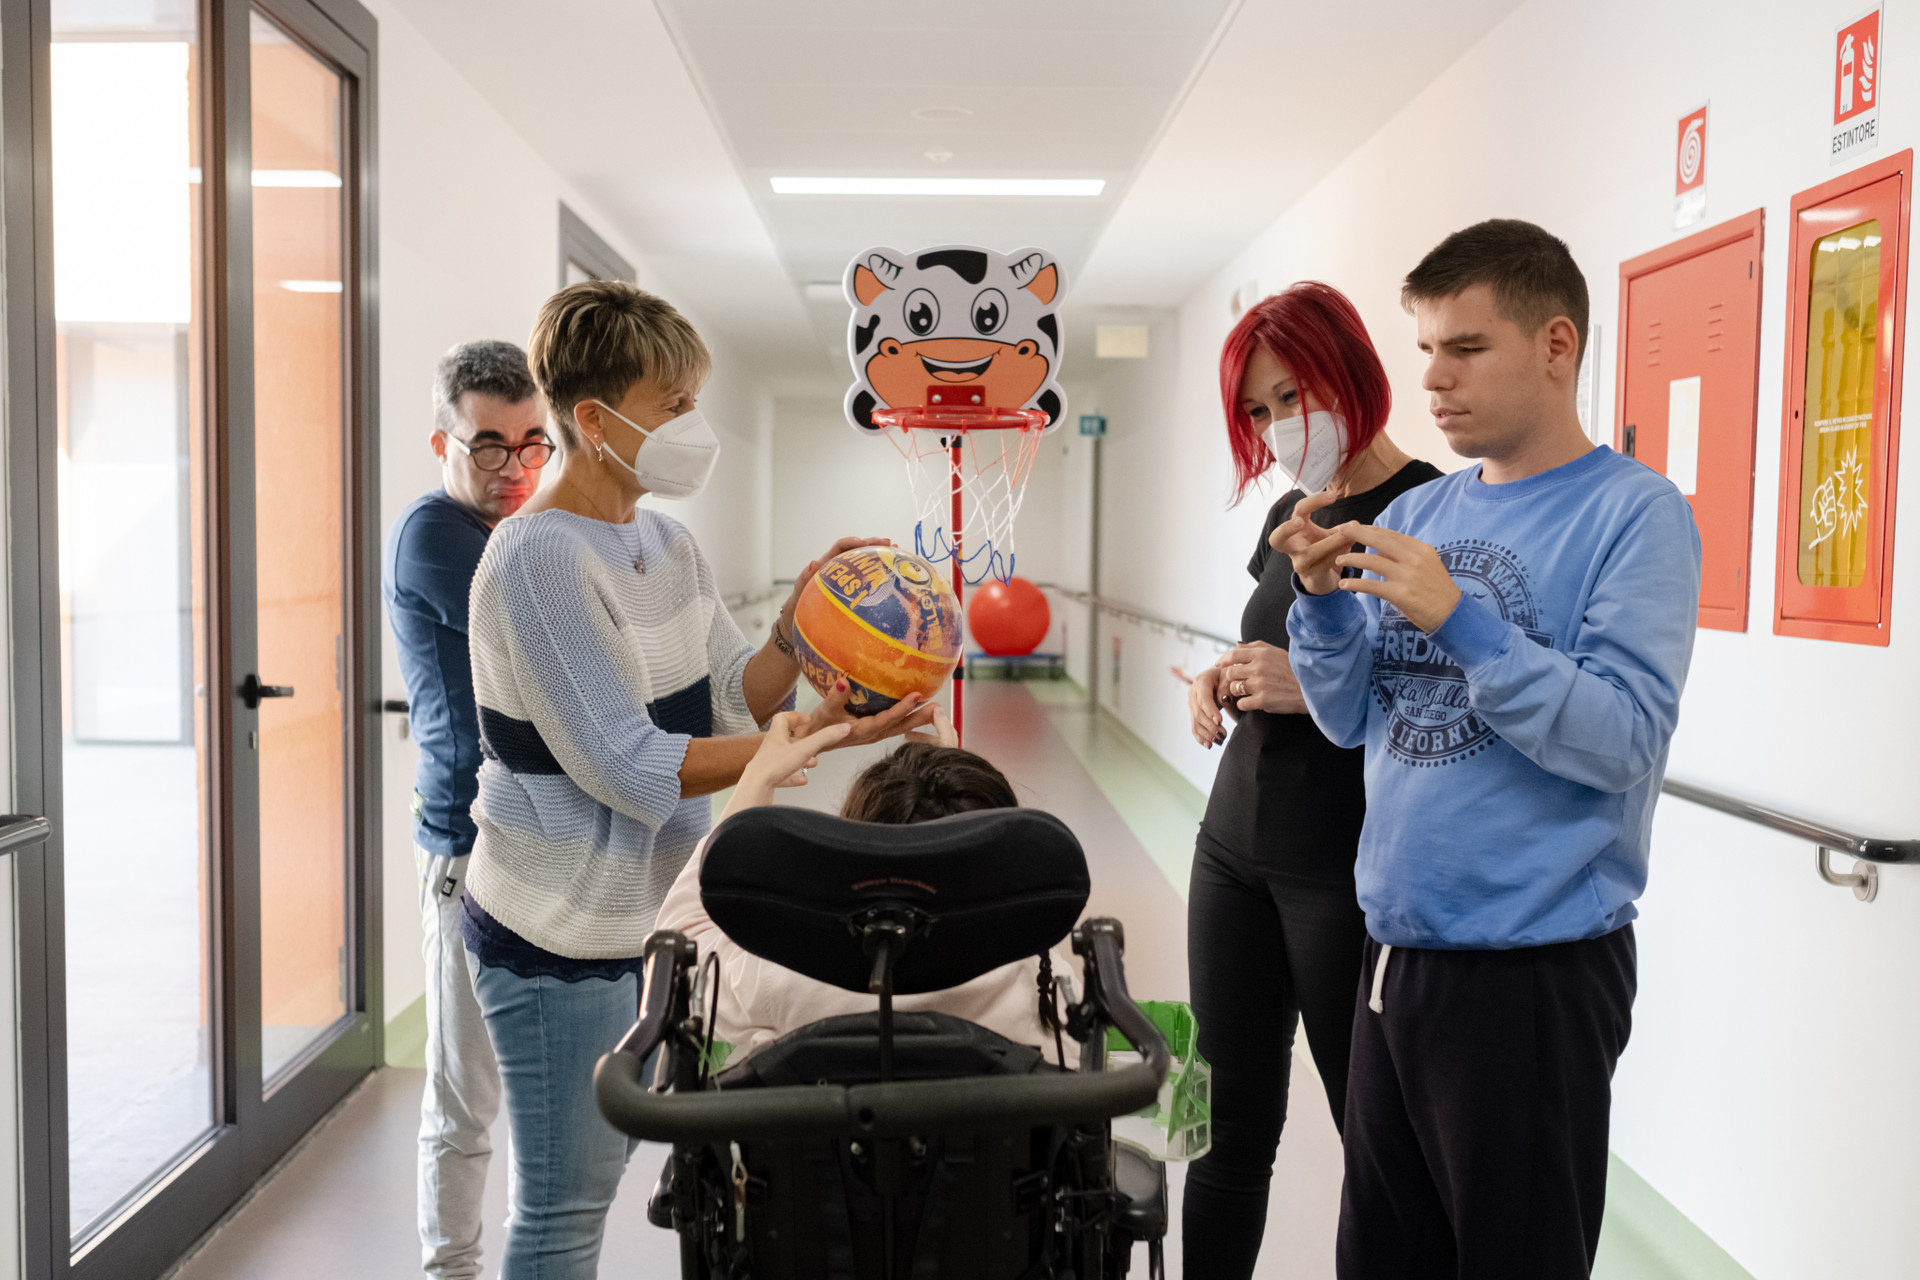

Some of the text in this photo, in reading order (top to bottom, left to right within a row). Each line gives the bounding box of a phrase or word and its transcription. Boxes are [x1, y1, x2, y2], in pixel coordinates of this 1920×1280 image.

[1832, 118, 1876, 154] ESTINTORE
[1450, 551, 1489, 574] THE
[1396, 679, 1470, 709] La Jolla
[1404, 705, 1423, 719] SAN
